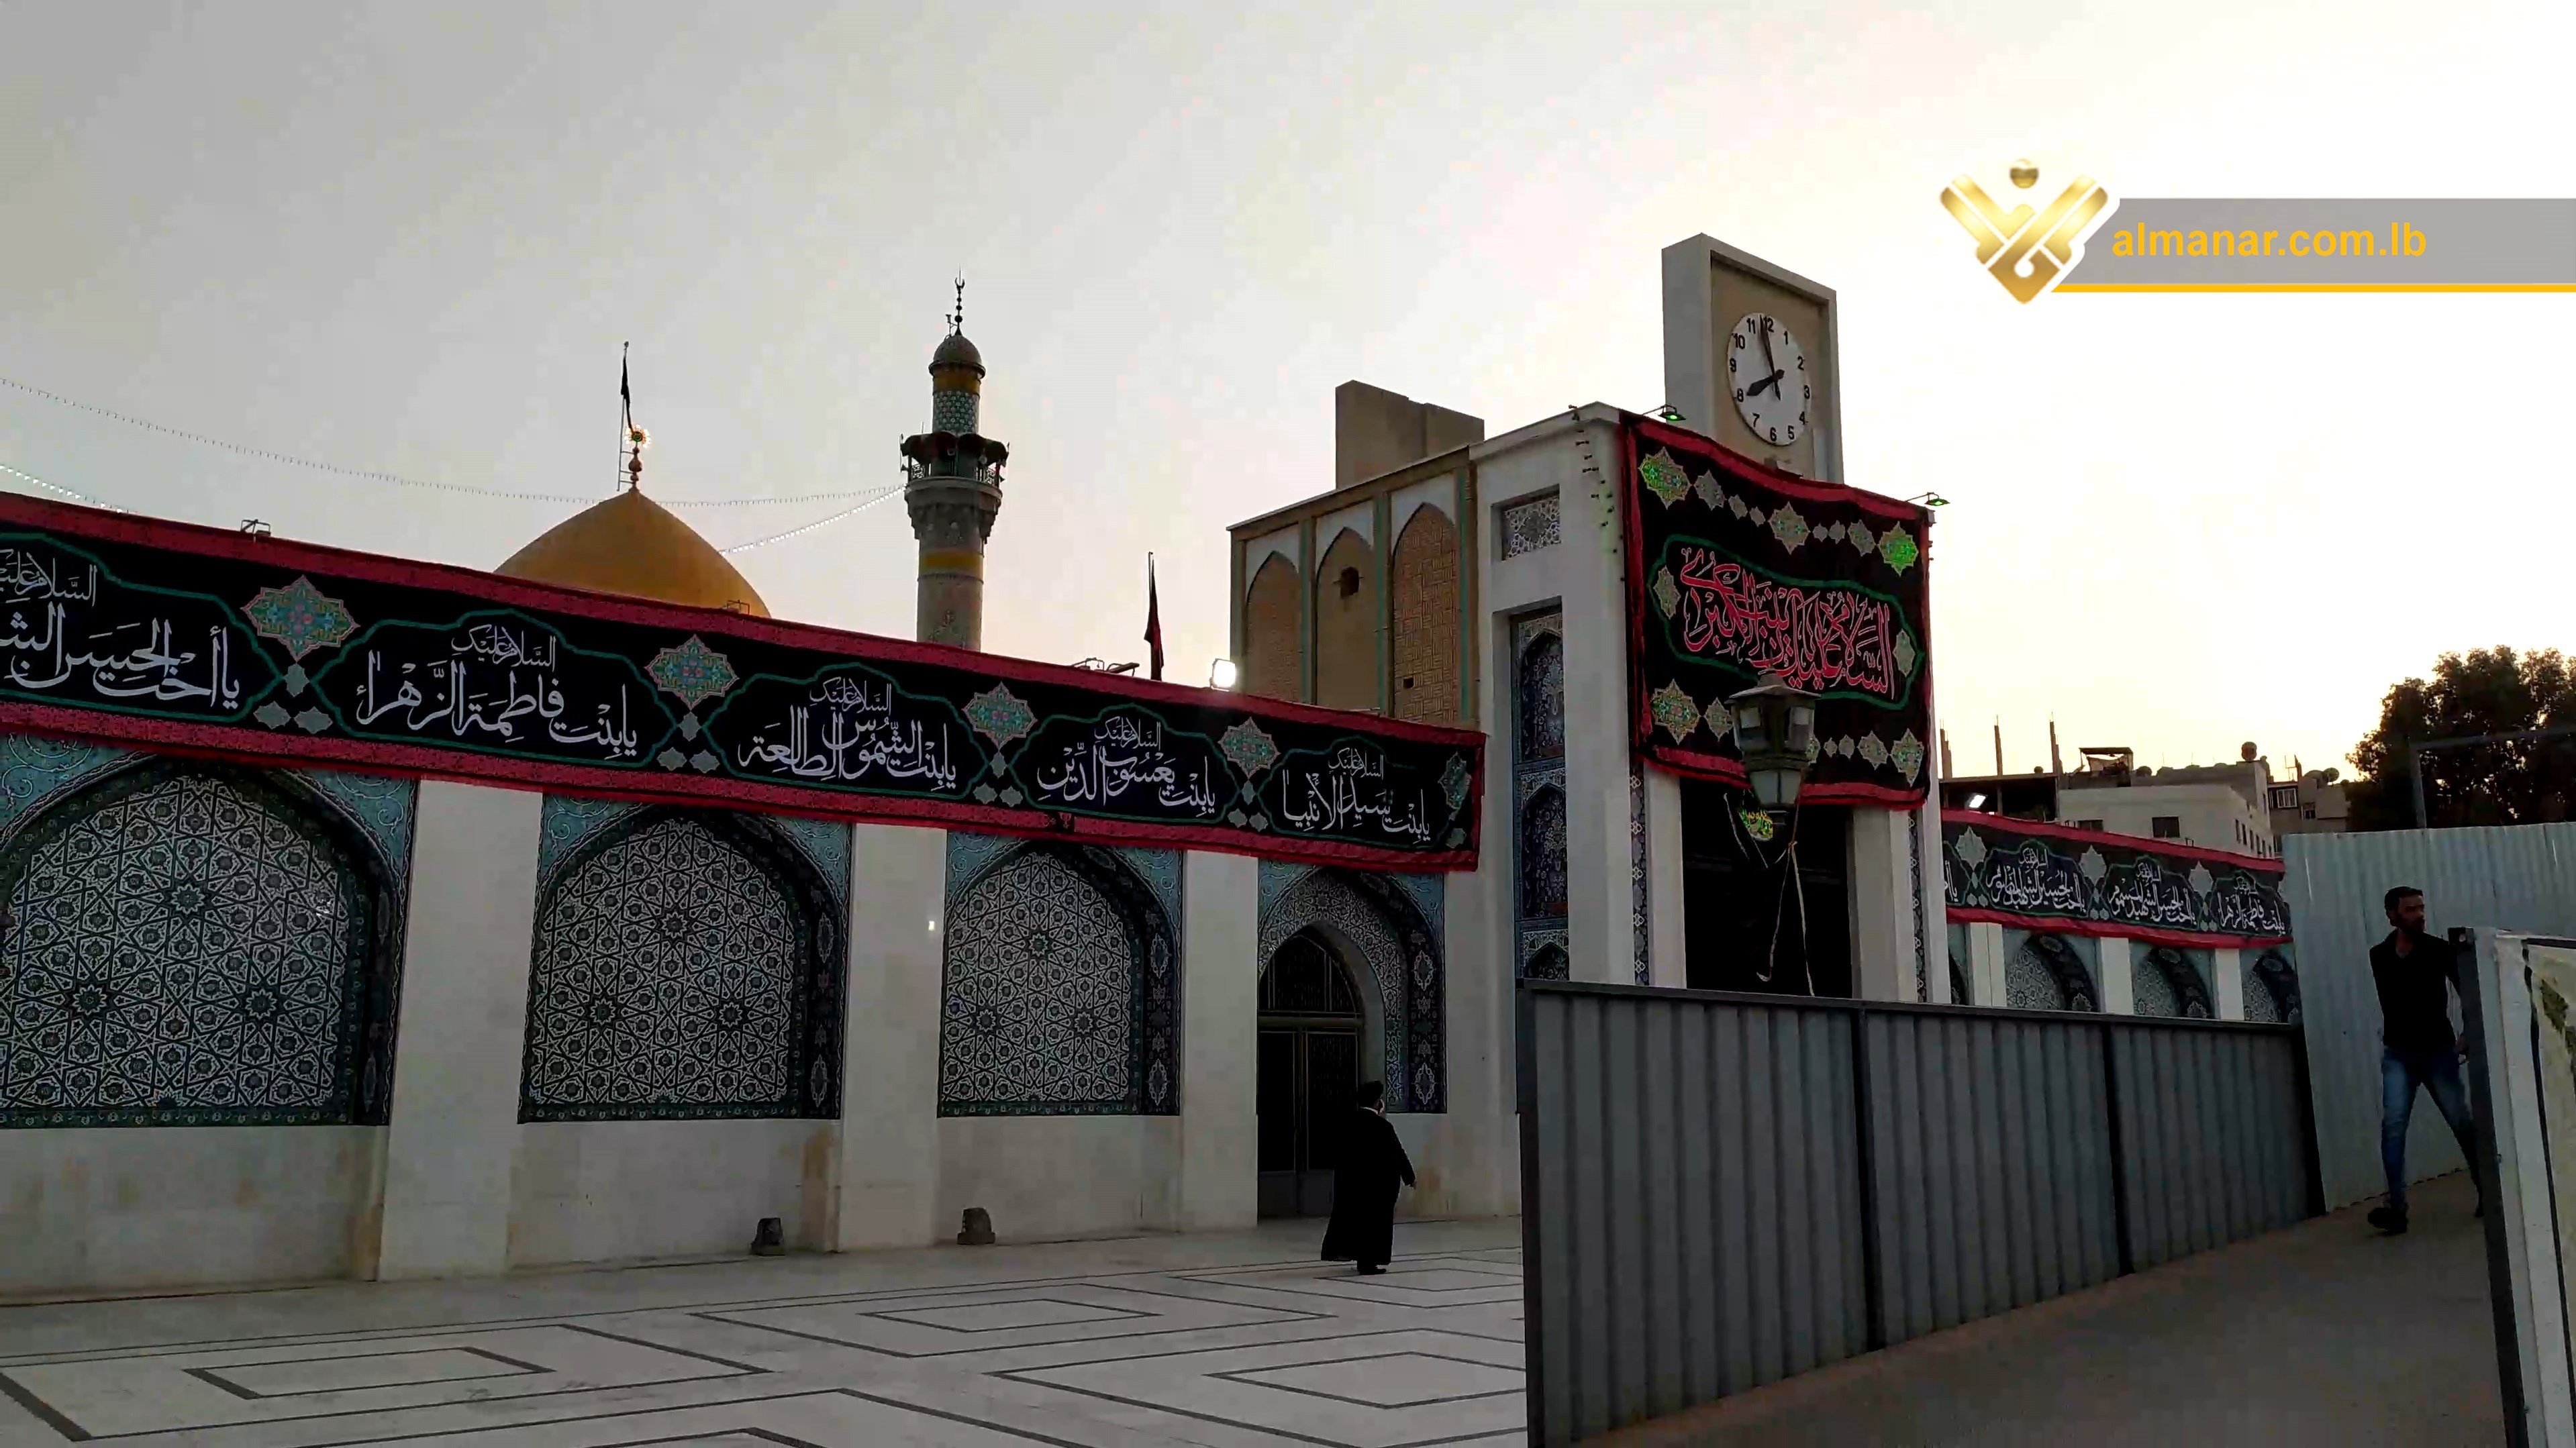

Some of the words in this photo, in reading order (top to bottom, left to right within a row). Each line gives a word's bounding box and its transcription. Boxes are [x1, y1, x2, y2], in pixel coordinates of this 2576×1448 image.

[1746, 317, 1756, 334] 11
[1732, 333, 1746, 350] 10
[1784, 331, 1789, 346] 1
[1729, 358, 1737, 372] 9
[1797, 356, 1805, 370] 2
[1736, 388, 1744, 403] 8
[1803, 385, 1810, 399] 3
[1752, 413, 1761, 427] 7
[1799, 411, 1806, 425] 4
[1769, 427, 1777, 442] 6
[1787, 425, 1795, 440] 5
